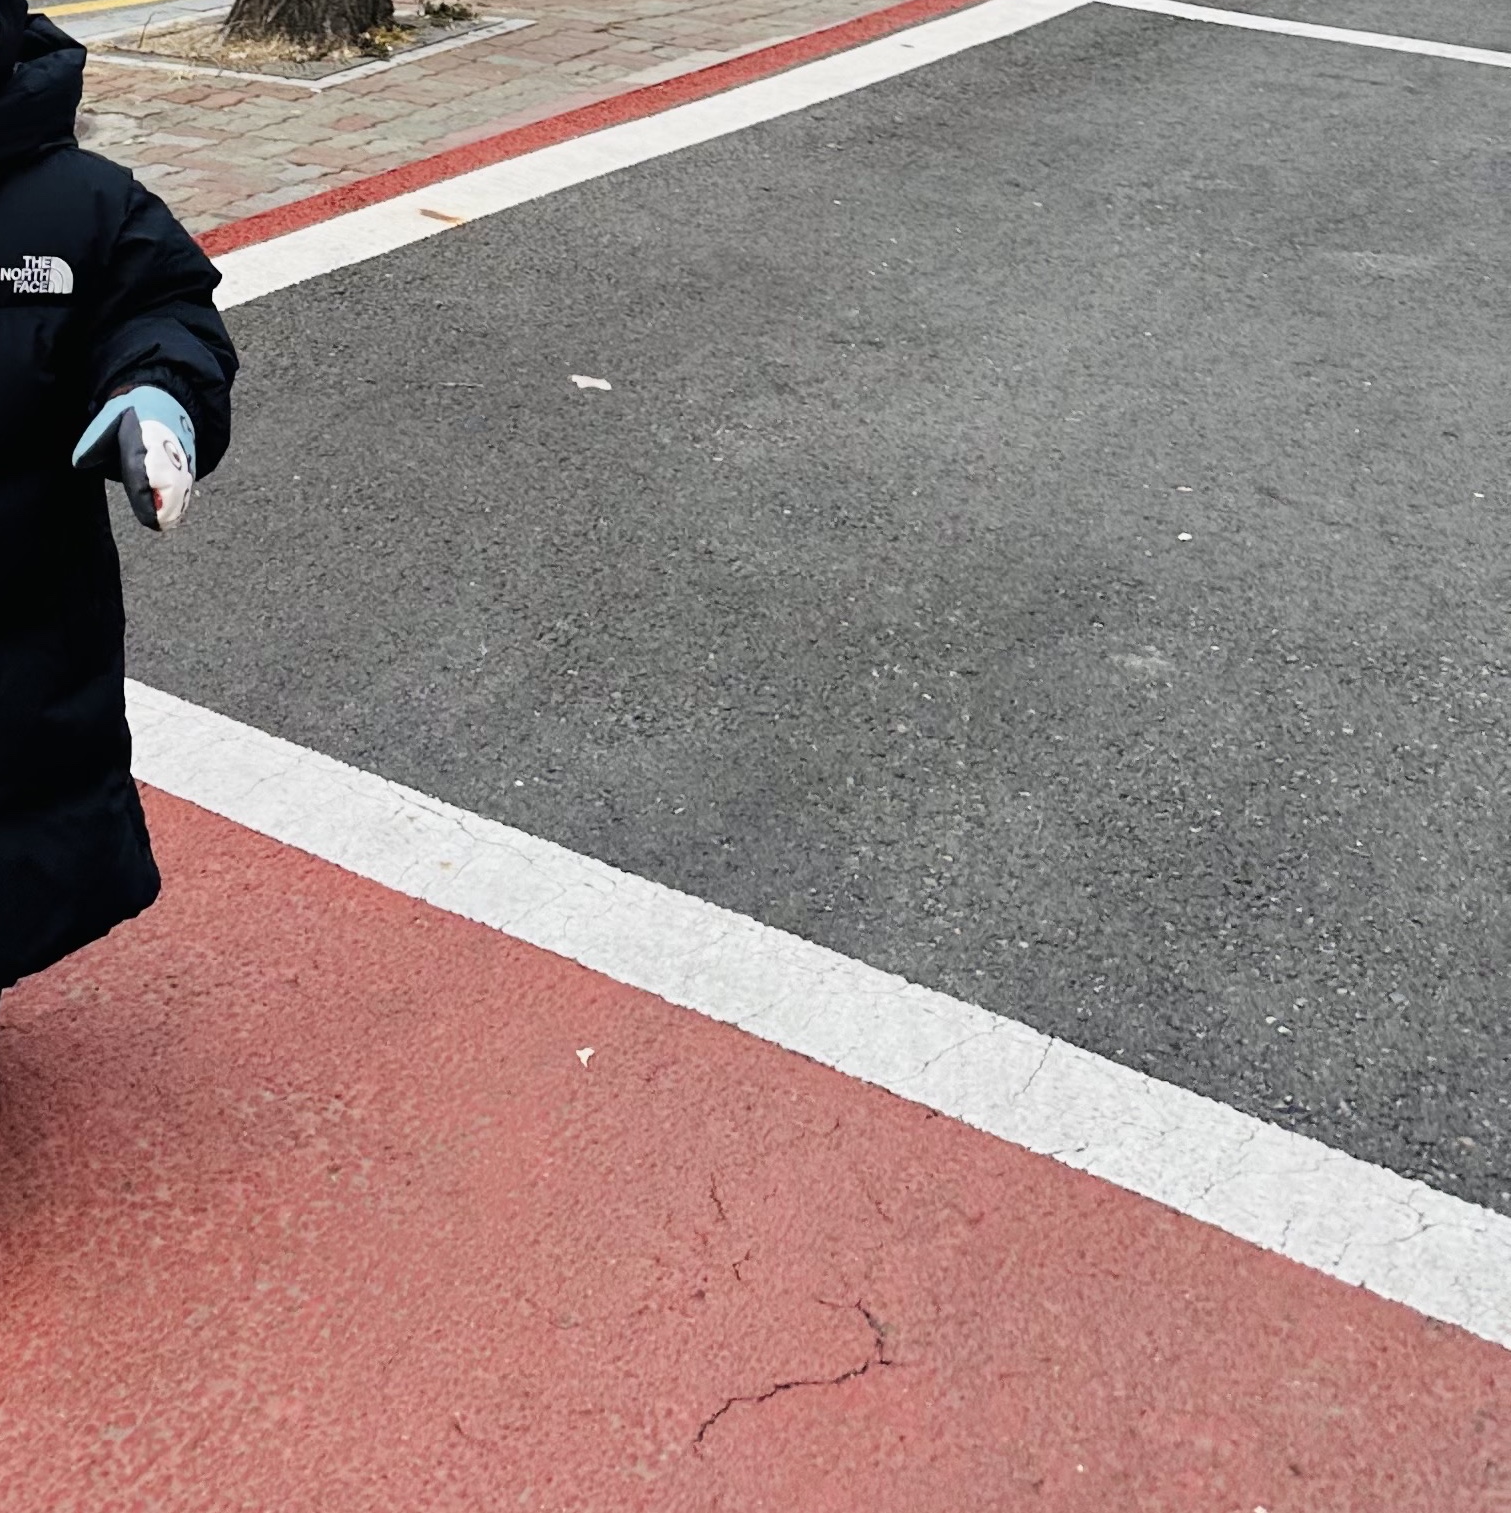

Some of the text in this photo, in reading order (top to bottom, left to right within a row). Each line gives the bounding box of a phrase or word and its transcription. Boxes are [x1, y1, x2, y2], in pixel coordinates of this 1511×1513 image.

[22, 255, 52, 269] THE
[0, 267, 50, 281] NORTH
[13, 280, 48, 294] FACE
